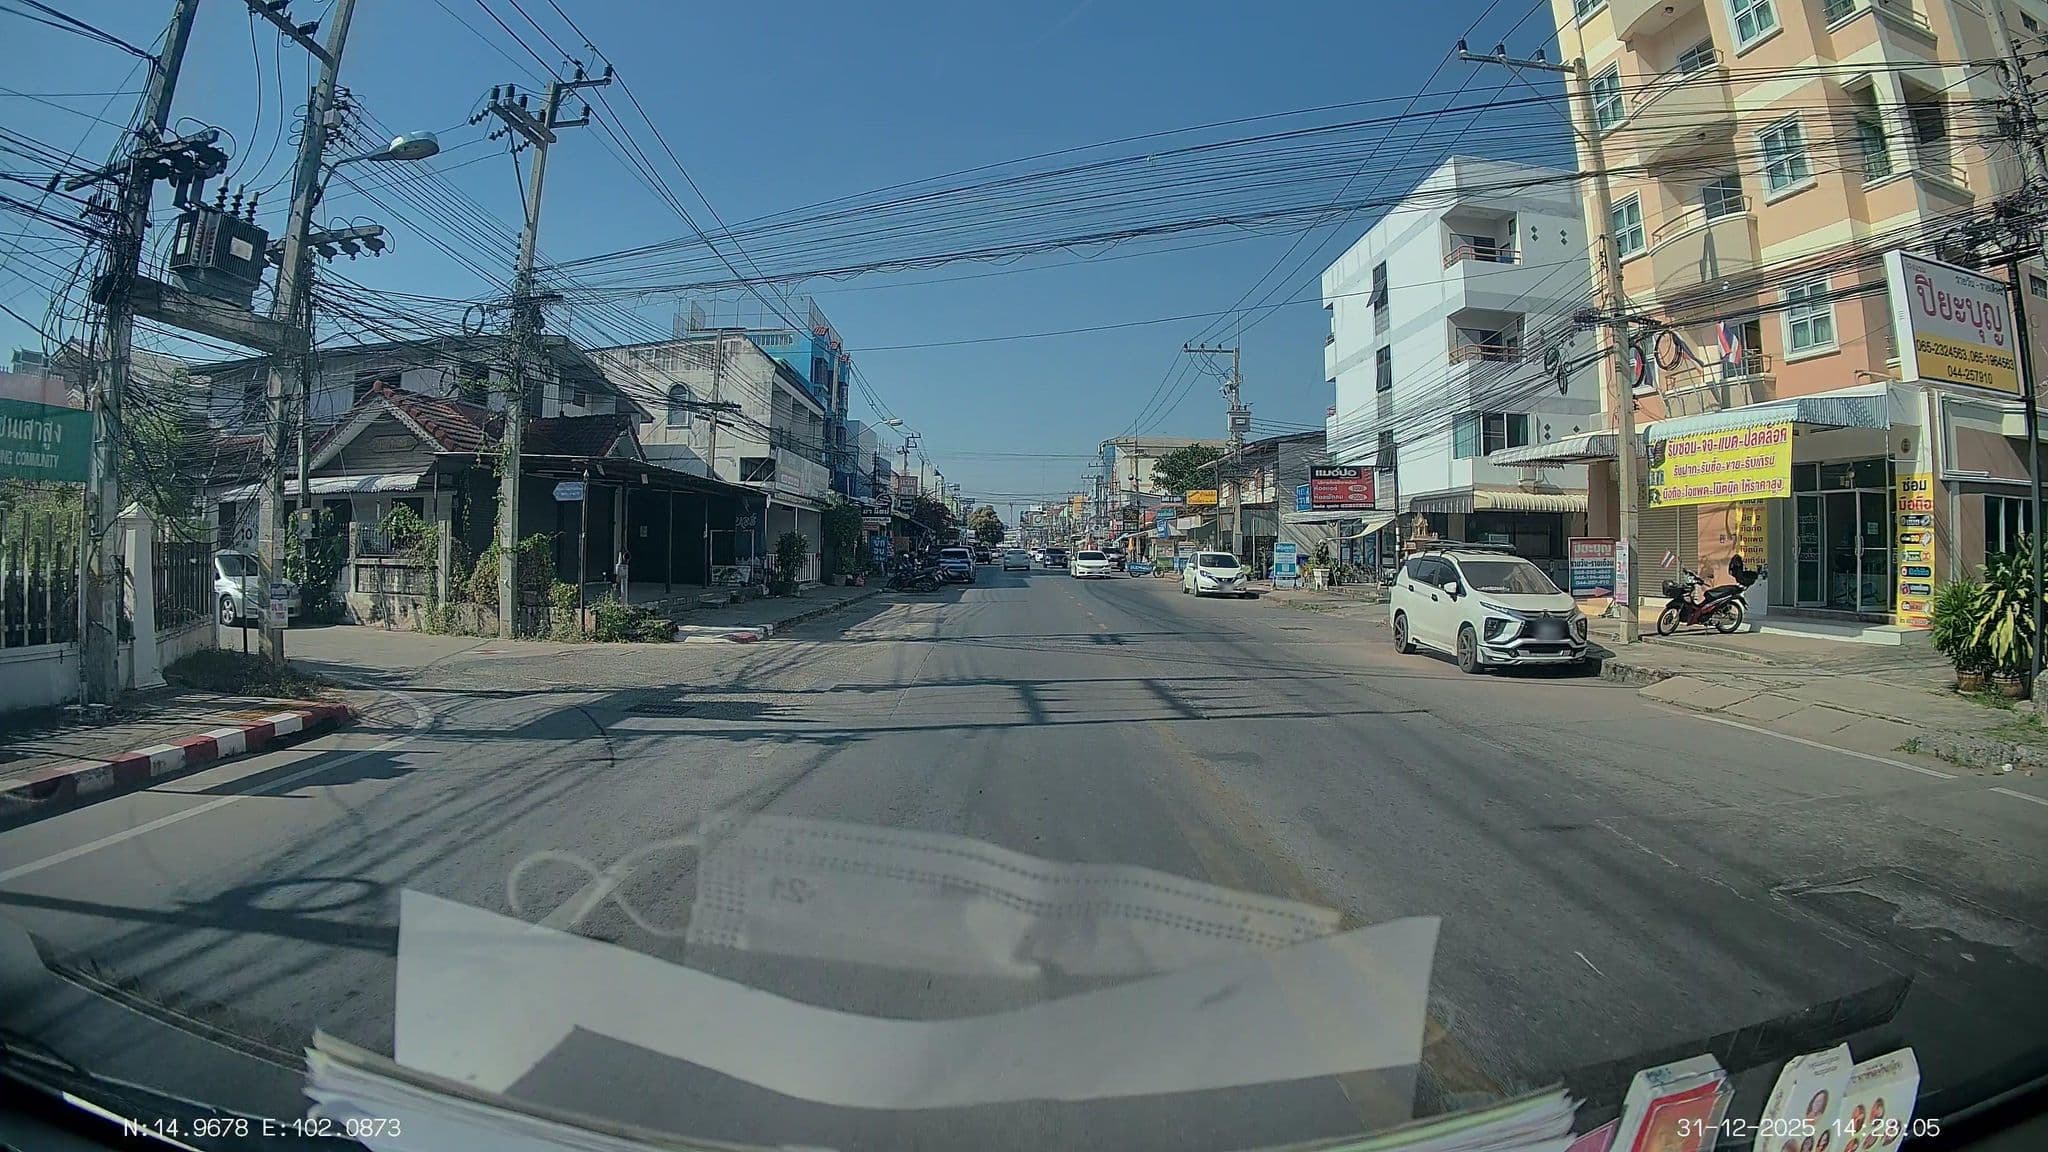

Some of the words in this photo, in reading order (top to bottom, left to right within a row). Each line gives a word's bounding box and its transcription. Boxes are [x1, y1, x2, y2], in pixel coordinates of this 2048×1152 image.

[1914, 273, 2004, 346] ปิยะบุญ
[15, 451, 60, 469] COMMUNITY
[1902, 477, 1927, 492] ซ่อม
[1899, 496, 1933, 511] มือถือ
